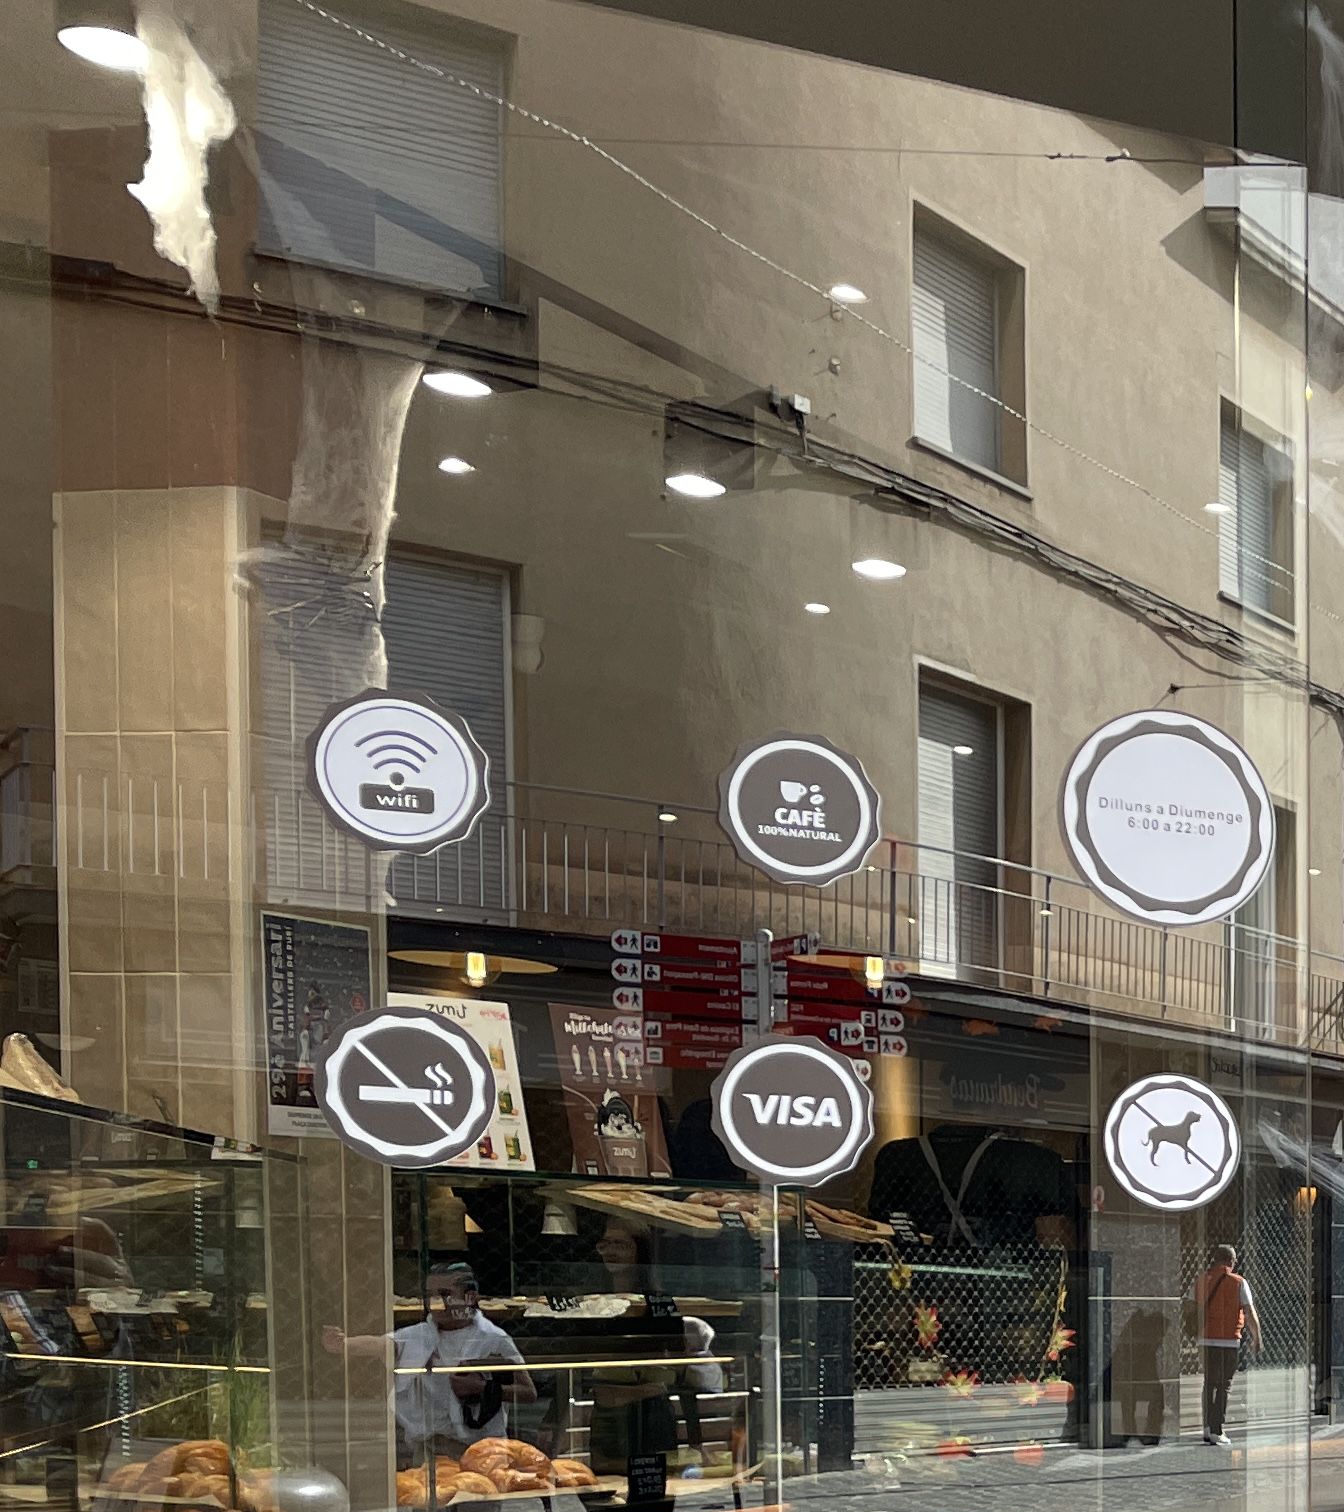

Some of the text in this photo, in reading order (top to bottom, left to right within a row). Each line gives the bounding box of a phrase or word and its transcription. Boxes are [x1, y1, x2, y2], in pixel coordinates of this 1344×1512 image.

[375, 791, 419, 809] wifi
[1097, 796, 1245, 825] Dilluns a Diumenge
[774, 806, 827, 829] CAFÈ
[1127, 816, 1216, 837] 6:00 a 22:00
[757, 824, 843, 843] 100%NATURAL
[265, 921, 286, 1050] Aniversari
[741, 1091, 843, 1128] VISA
